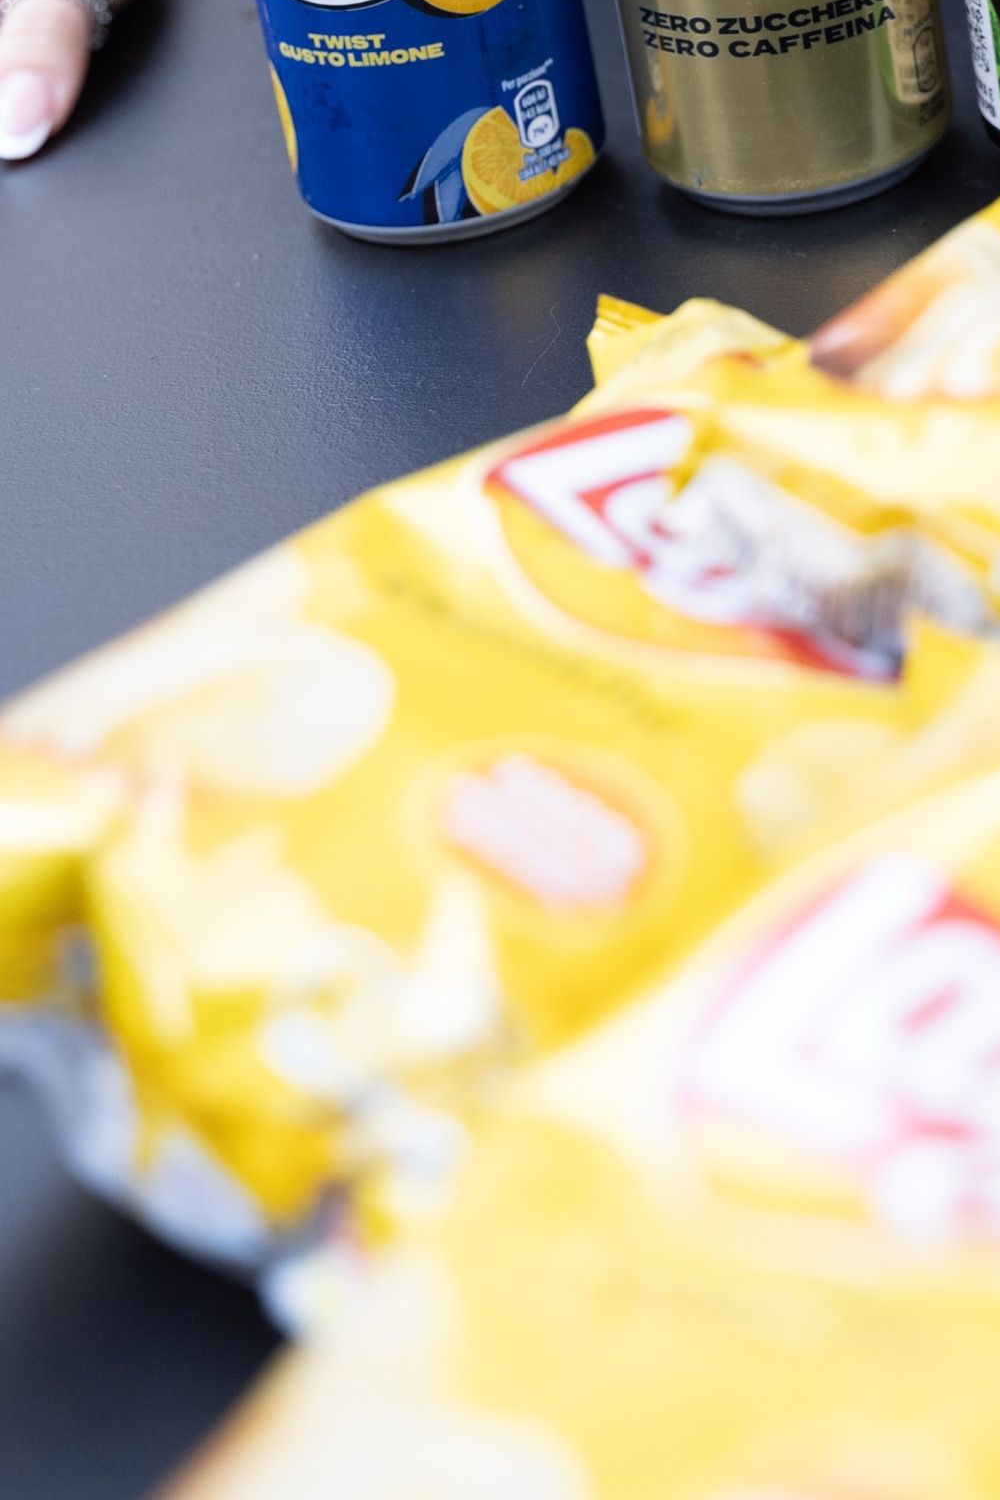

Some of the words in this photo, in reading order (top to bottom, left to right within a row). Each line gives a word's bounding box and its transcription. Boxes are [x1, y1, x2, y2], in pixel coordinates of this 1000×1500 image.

[638, 5, 712, 35] ZERO
[643, 29, 720, 59] ZERO
[727, 5, 896, 59] CAFFEINA
[278, 41, 346, 68] GUSTO
[345, 42, 445, 68] LIMONE
[308, 32, 386, 50] TWIST
[501, 79, 516, 92] Per
